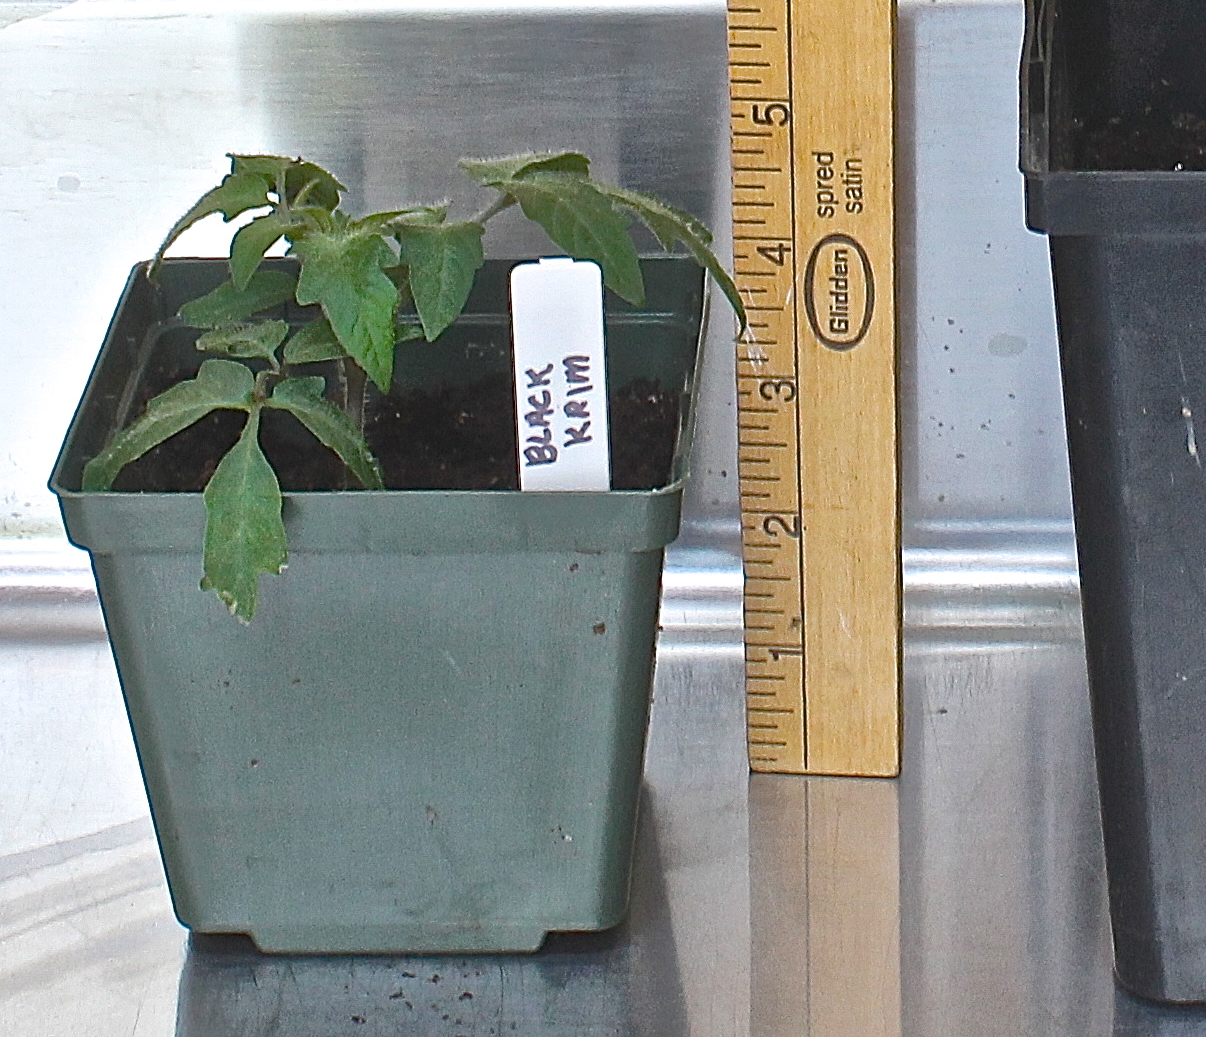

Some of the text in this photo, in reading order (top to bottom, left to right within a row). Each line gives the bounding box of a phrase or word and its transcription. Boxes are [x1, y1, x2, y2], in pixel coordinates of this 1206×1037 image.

[753, 103, 790, 127] 5
[812, 150, 839, 220] spred
[840, 158, 864, 215] satin
[757, 242, 791, 267] 4
[829, 249, 849, 334] Glidden
[562, 355, 594, 448] KRIM
[759, 379, 796, 403] 3
[523, 363, 558, 467] BLACK
[764, 515, 798, 538] 2
[768, 648, 803, 662] 1
